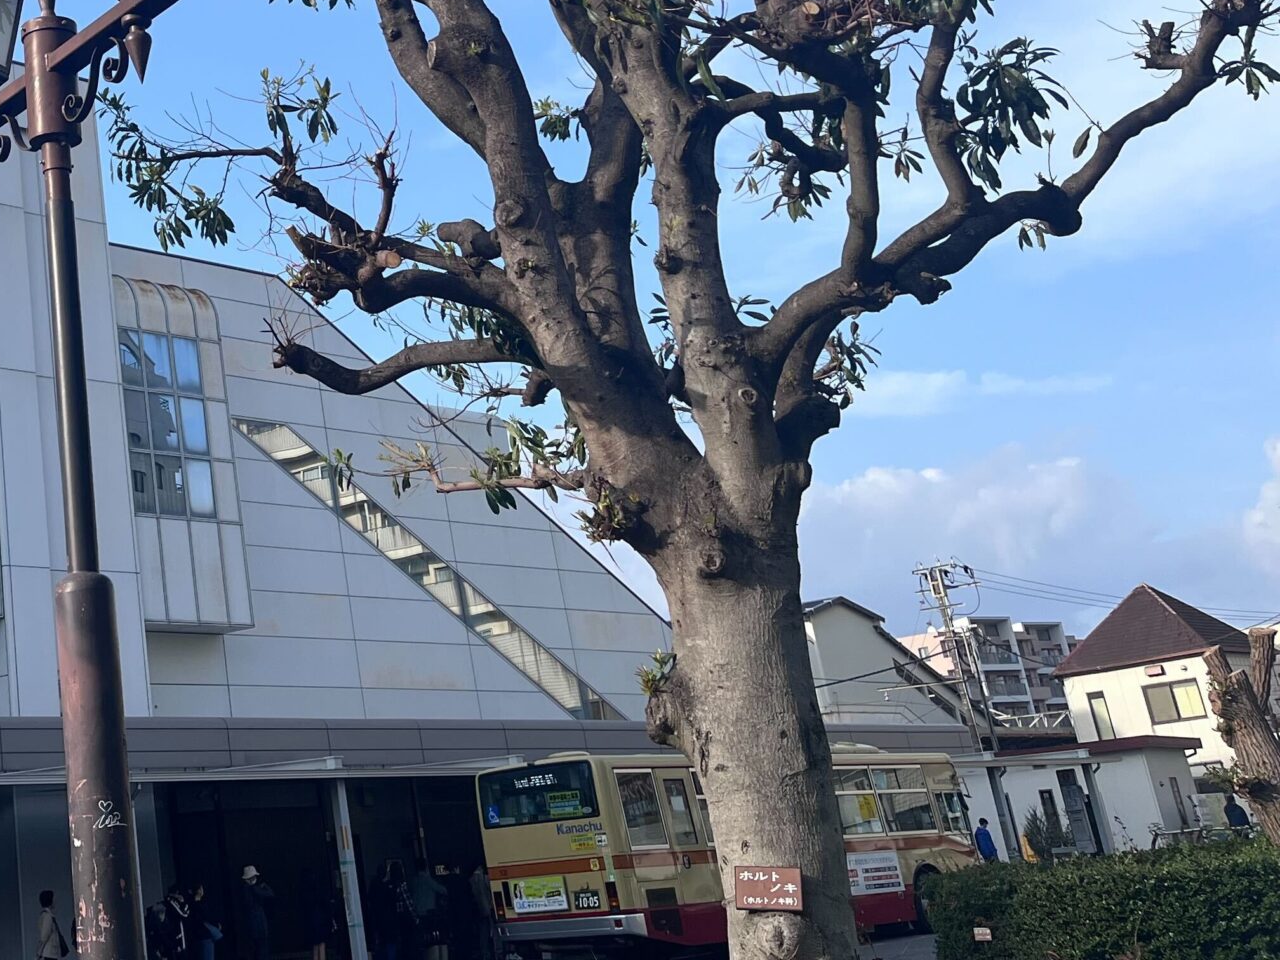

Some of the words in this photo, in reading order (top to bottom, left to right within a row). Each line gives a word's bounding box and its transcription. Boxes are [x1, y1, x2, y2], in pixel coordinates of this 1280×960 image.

[556, 821, 603, 836] Kanachu
[739, 871, 780, 882] ホルト
[770, 883, 798, 894] ノキ
